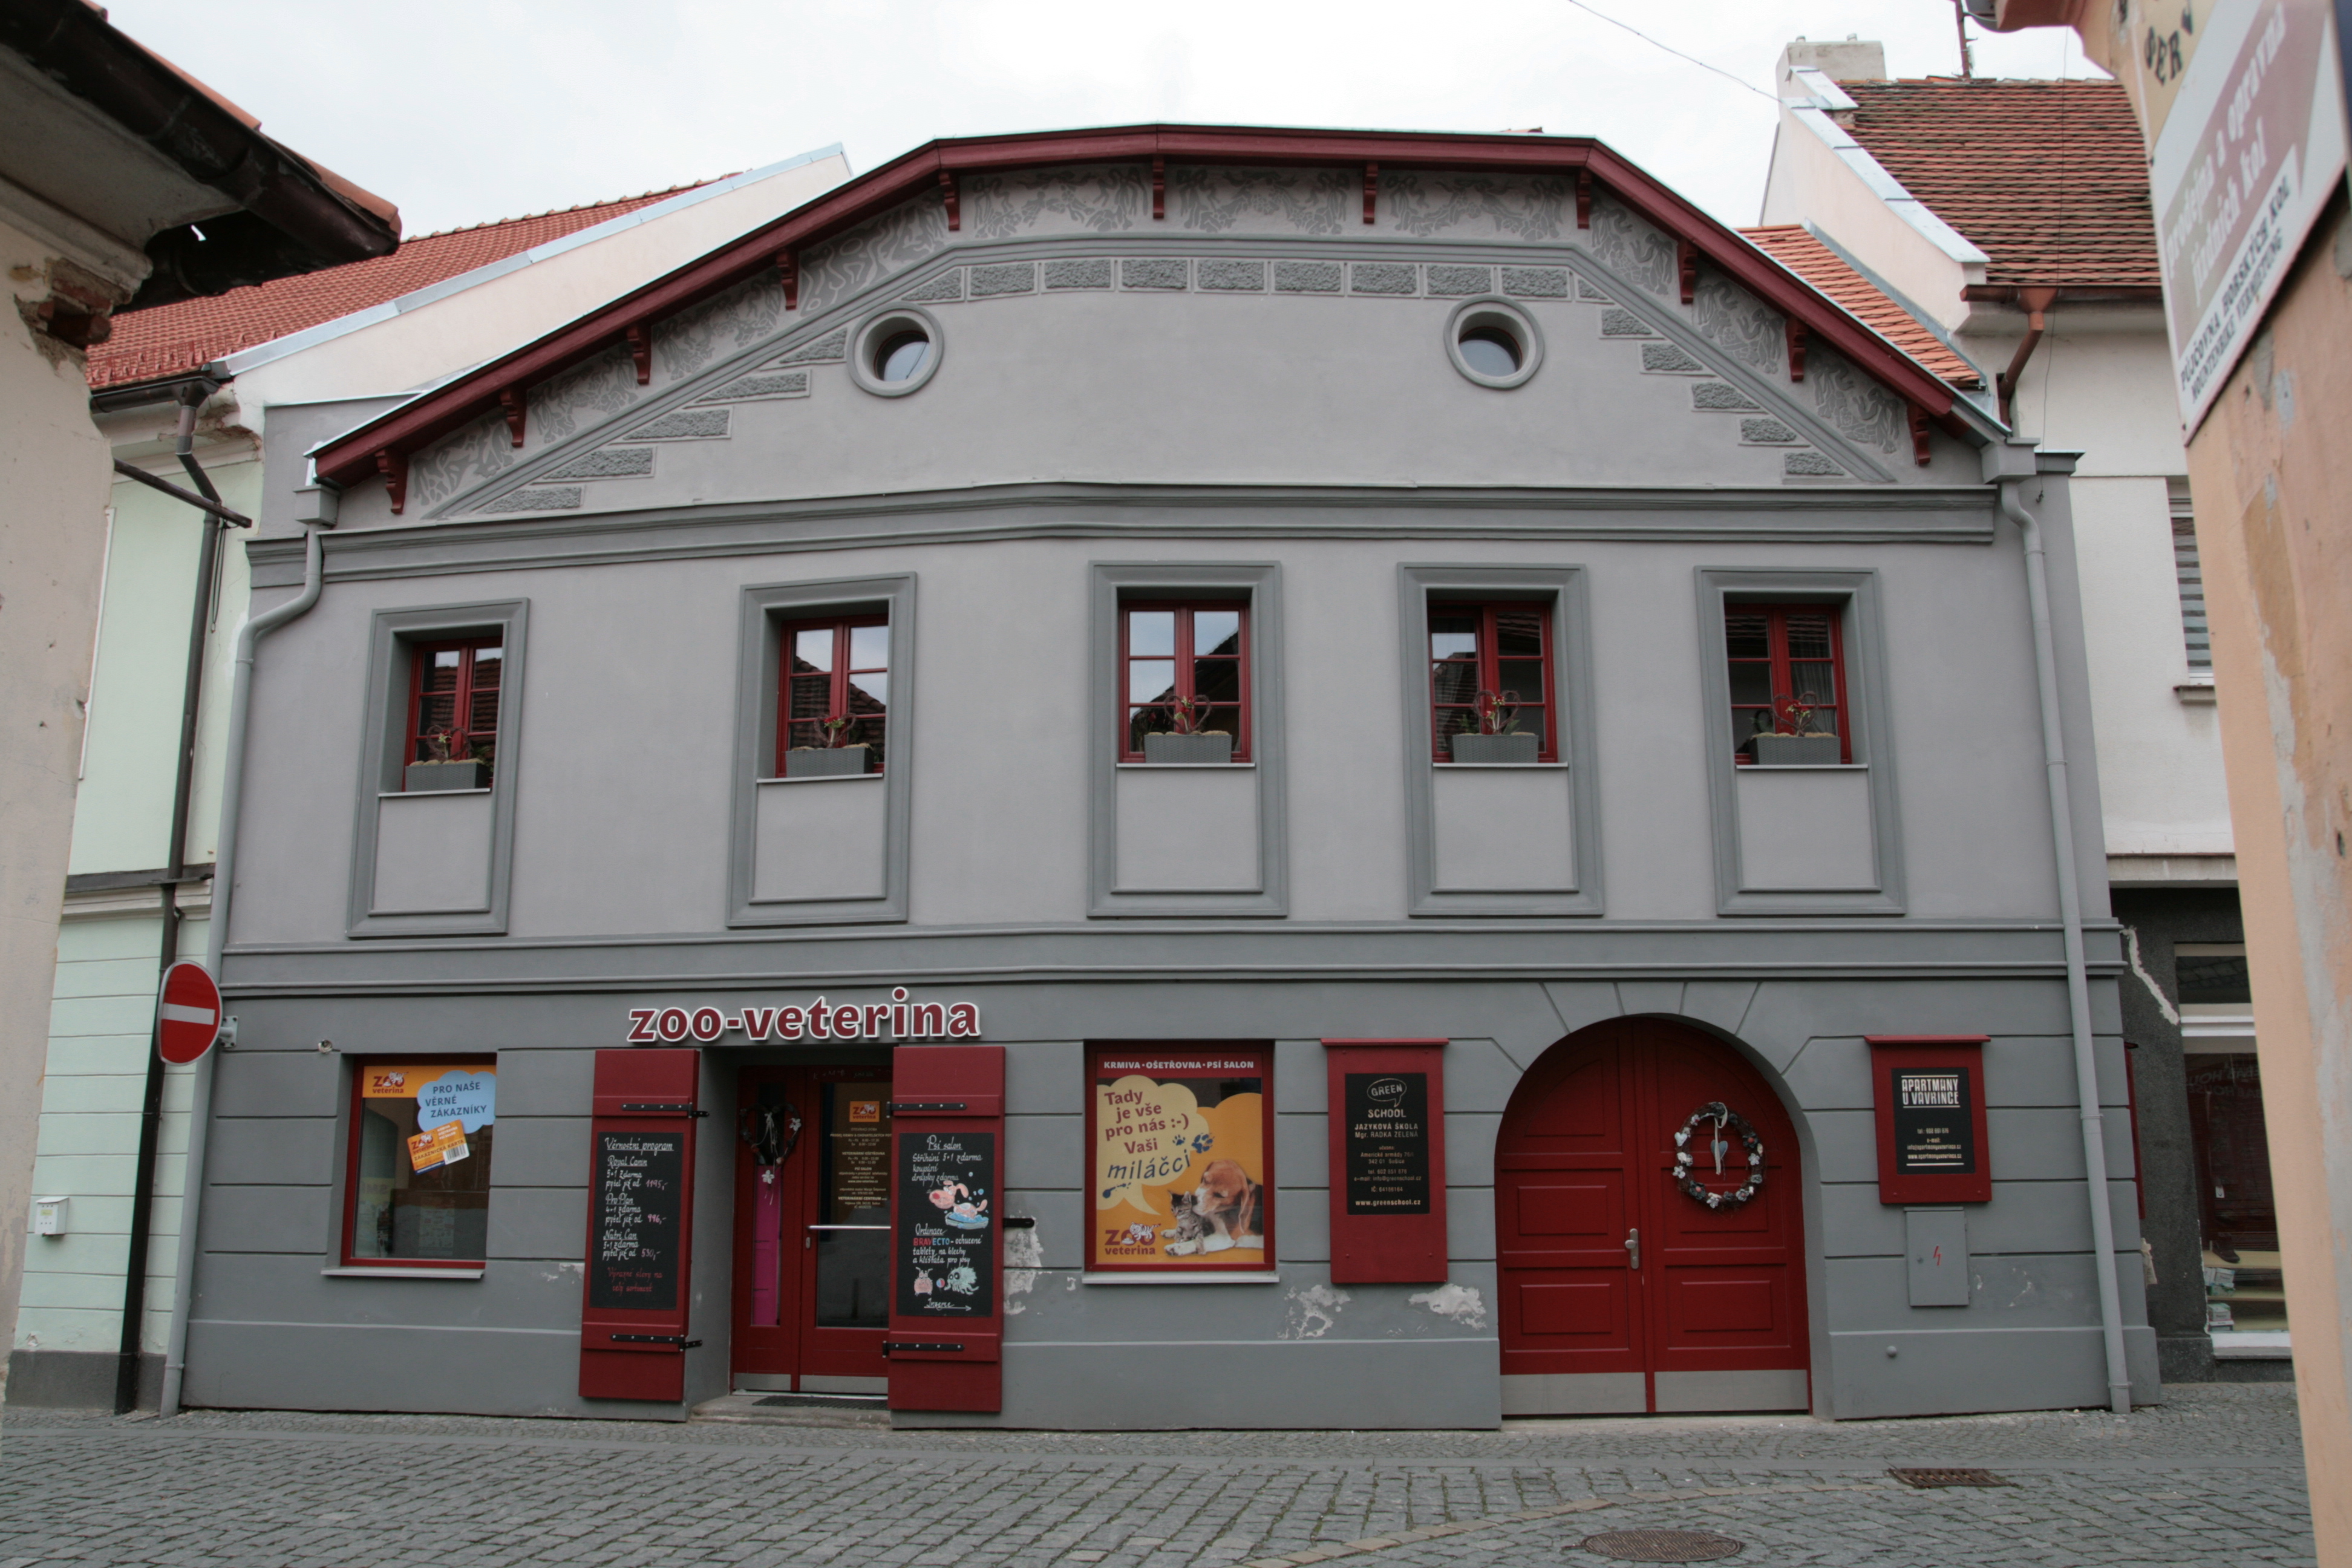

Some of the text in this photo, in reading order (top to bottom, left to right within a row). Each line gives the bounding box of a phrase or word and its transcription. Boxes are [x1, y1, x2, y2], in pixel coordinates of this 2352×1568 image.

[2166, 2, 2285, 280] prodejna a opravna
[2240, 117, 2267, 200] kol
[2269, 175, 2290, 224] KOL
[626, 986, 982, 1043] zoo-veterina
[1146, 1060, 1201, 1069] OŠETŘOVNA
[1207, 1060, 1221, 1069] PSÍ
[433, 1082, 481, 1094] PRO NAŠE
[1371, 1084, 1403, 1096] GREEN
[425, 1096, 457, 1106] VĚRNÉ
[1104, 1089, 1143, 1105] Tady
[1903, 1092, 1909, 1105] U
[431, 1105, 487, 1118] ZÁKAZNÍKY
[1116, 1103, 1161, 1123] je vše
[1368, 1109, 1406, 1118] SCHOOL
[1105, 1125, 1134, 1142] pro
[1138, 1119, 1166, 1133] nás
[927, 1134, 962, 1150] Psí salon
[1124, 1138, 1158, 1154] Vaši
[641, 1142, 673, 1156] program
[607, 1155, 627, 1169] Royal
[956, 1152, 983, 1164] zdarma
[1108, 1149, 1191, 1179] miláčci
[936, 1172, 959, 1185] zdarma
[605, 1192, 634, 1204] Pro Plan
[613, 1240, 639, 1250] zdarma
[913, 1238, 950, 1246] BRAVECTO
[1105, 1245, 1155, 1255] veterina
